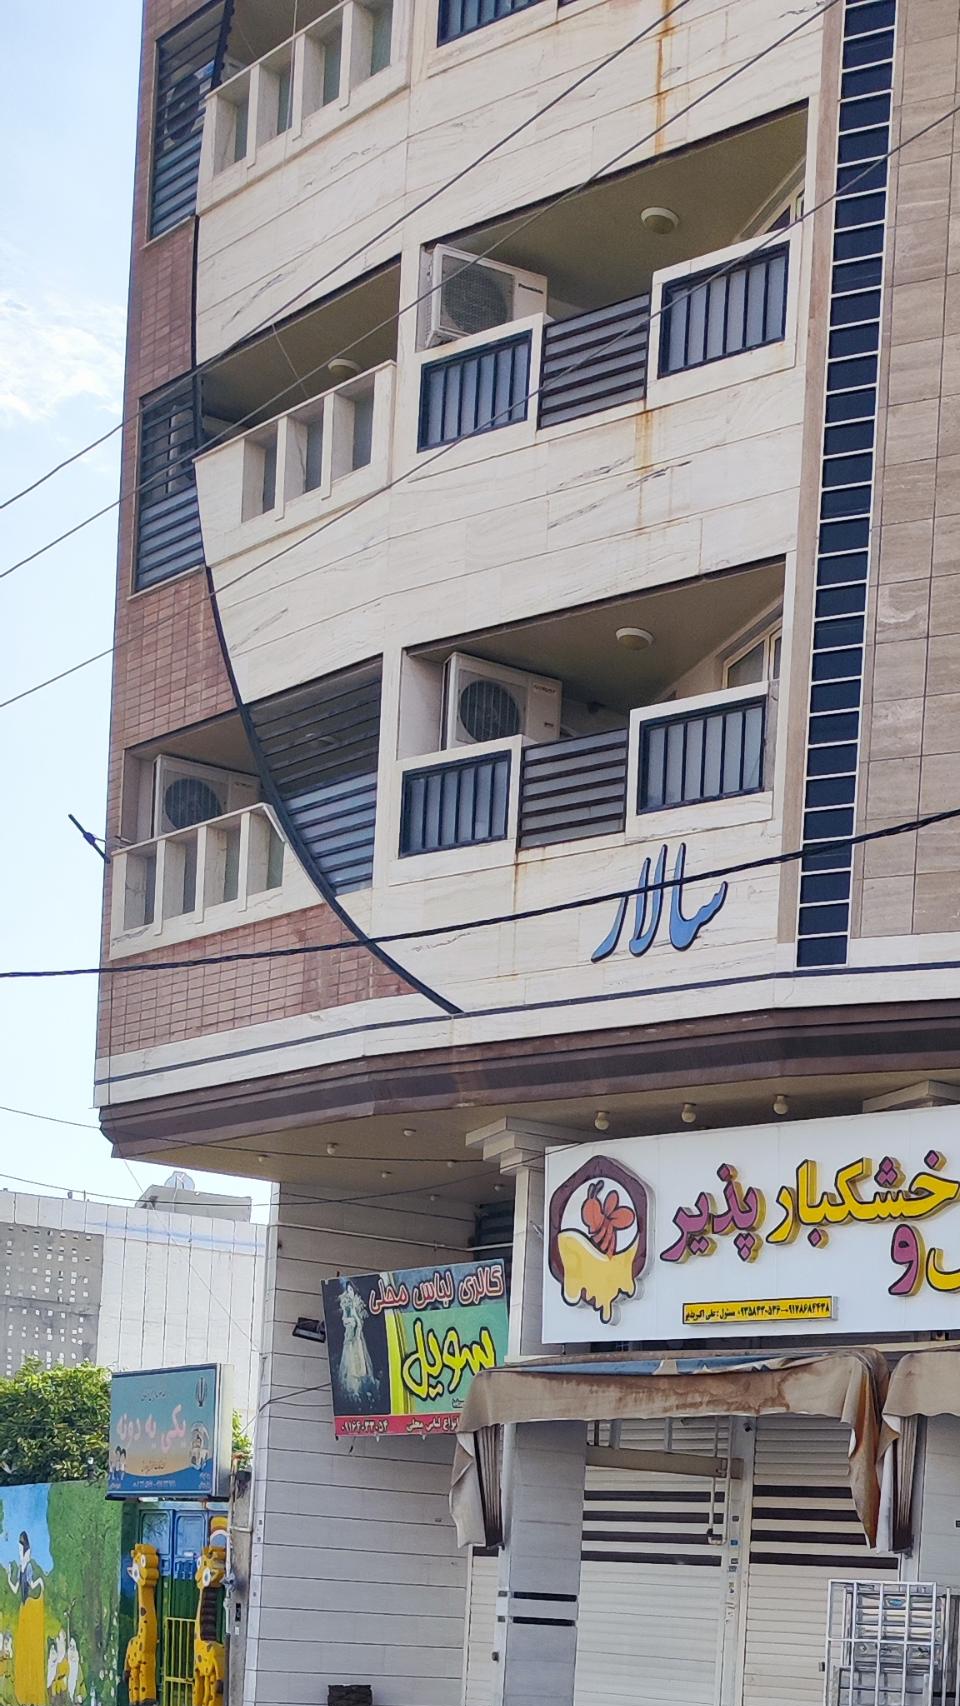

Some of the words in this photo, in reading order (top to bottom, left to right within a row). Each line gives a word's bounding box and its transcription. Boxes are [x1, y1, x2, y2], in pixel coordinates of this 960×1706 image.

[660, 1163, 766, 1263] پذیر
[413, 1270, 454, 1310] لباس
[888, 1223, 925, 1296] و
[369, 1278, 410, 1315] محلی
[402, 1317, 496, 1401] سویل
